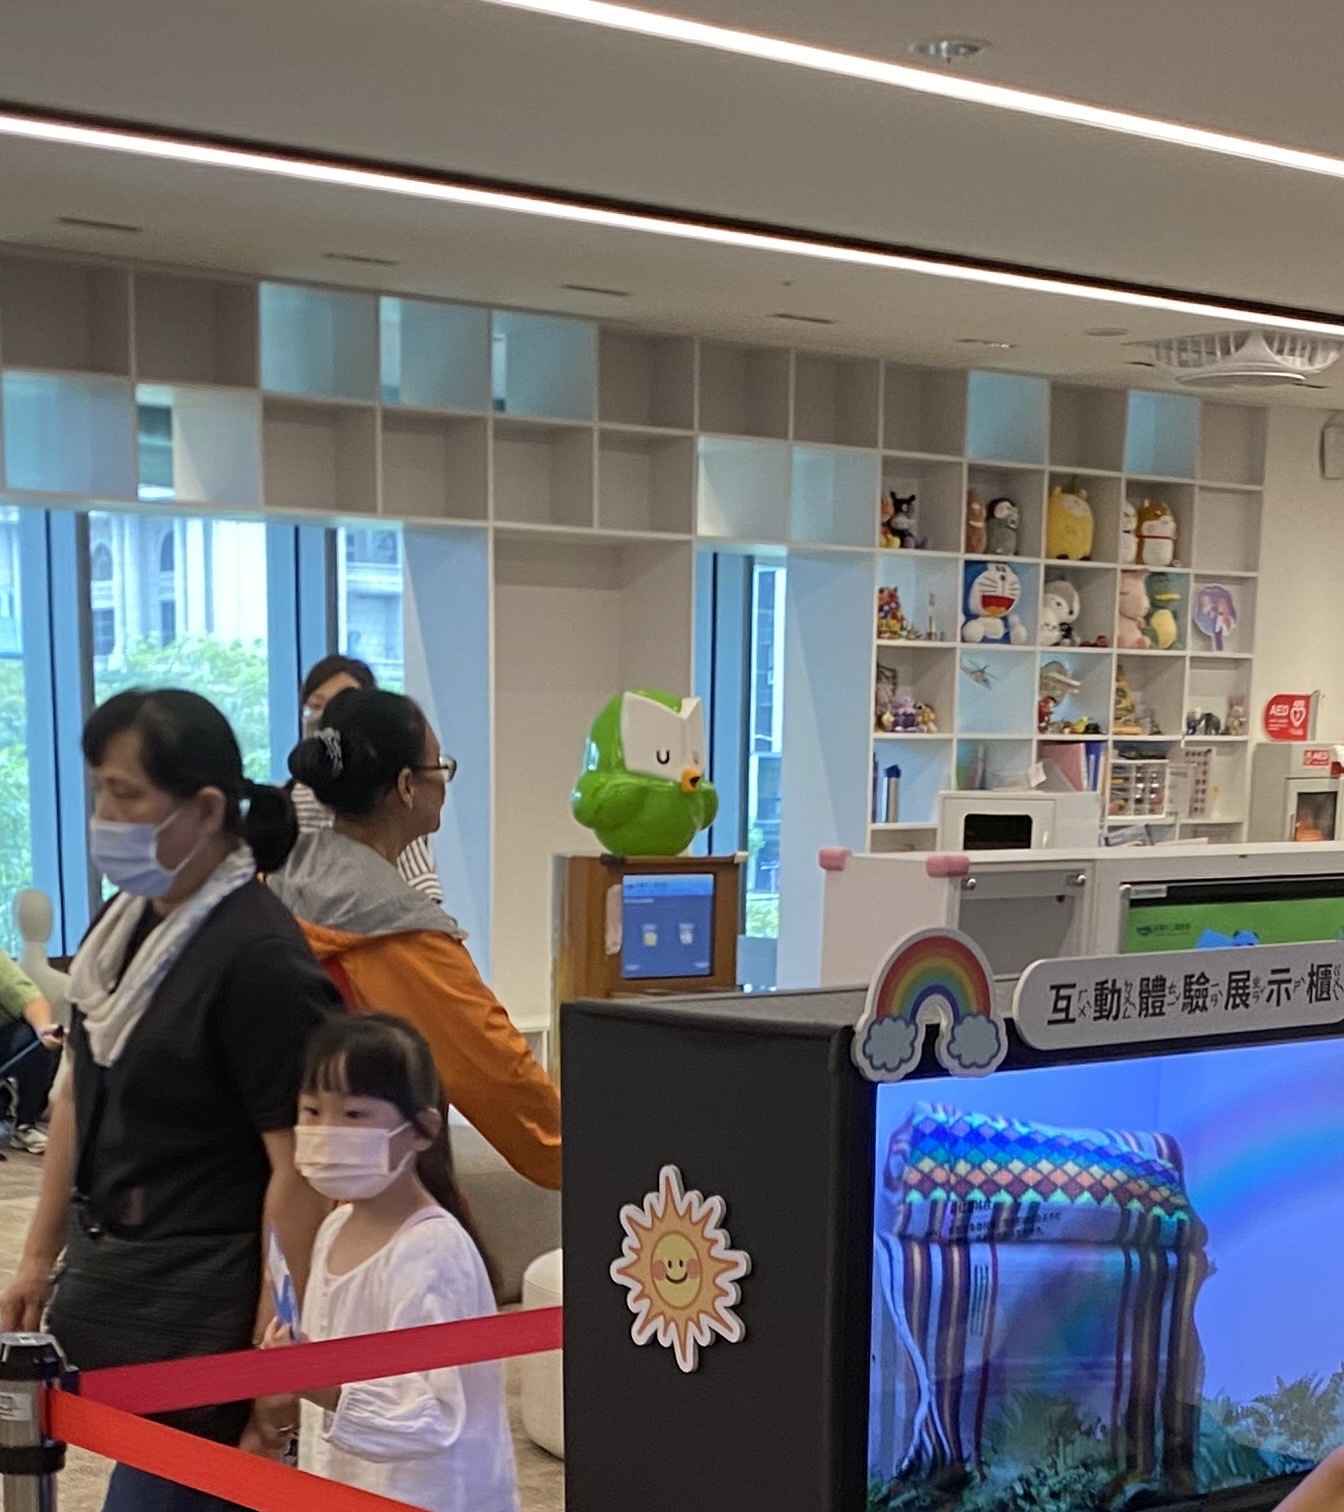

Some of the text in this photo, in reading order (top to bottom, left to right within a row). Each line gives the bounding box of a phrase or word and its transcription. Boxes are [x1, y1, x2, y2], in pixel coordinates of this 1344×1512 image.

[1269, 704, 1290, 716] AED
[1047, 963, 1333, 1026] 互動體驗展示櫃
